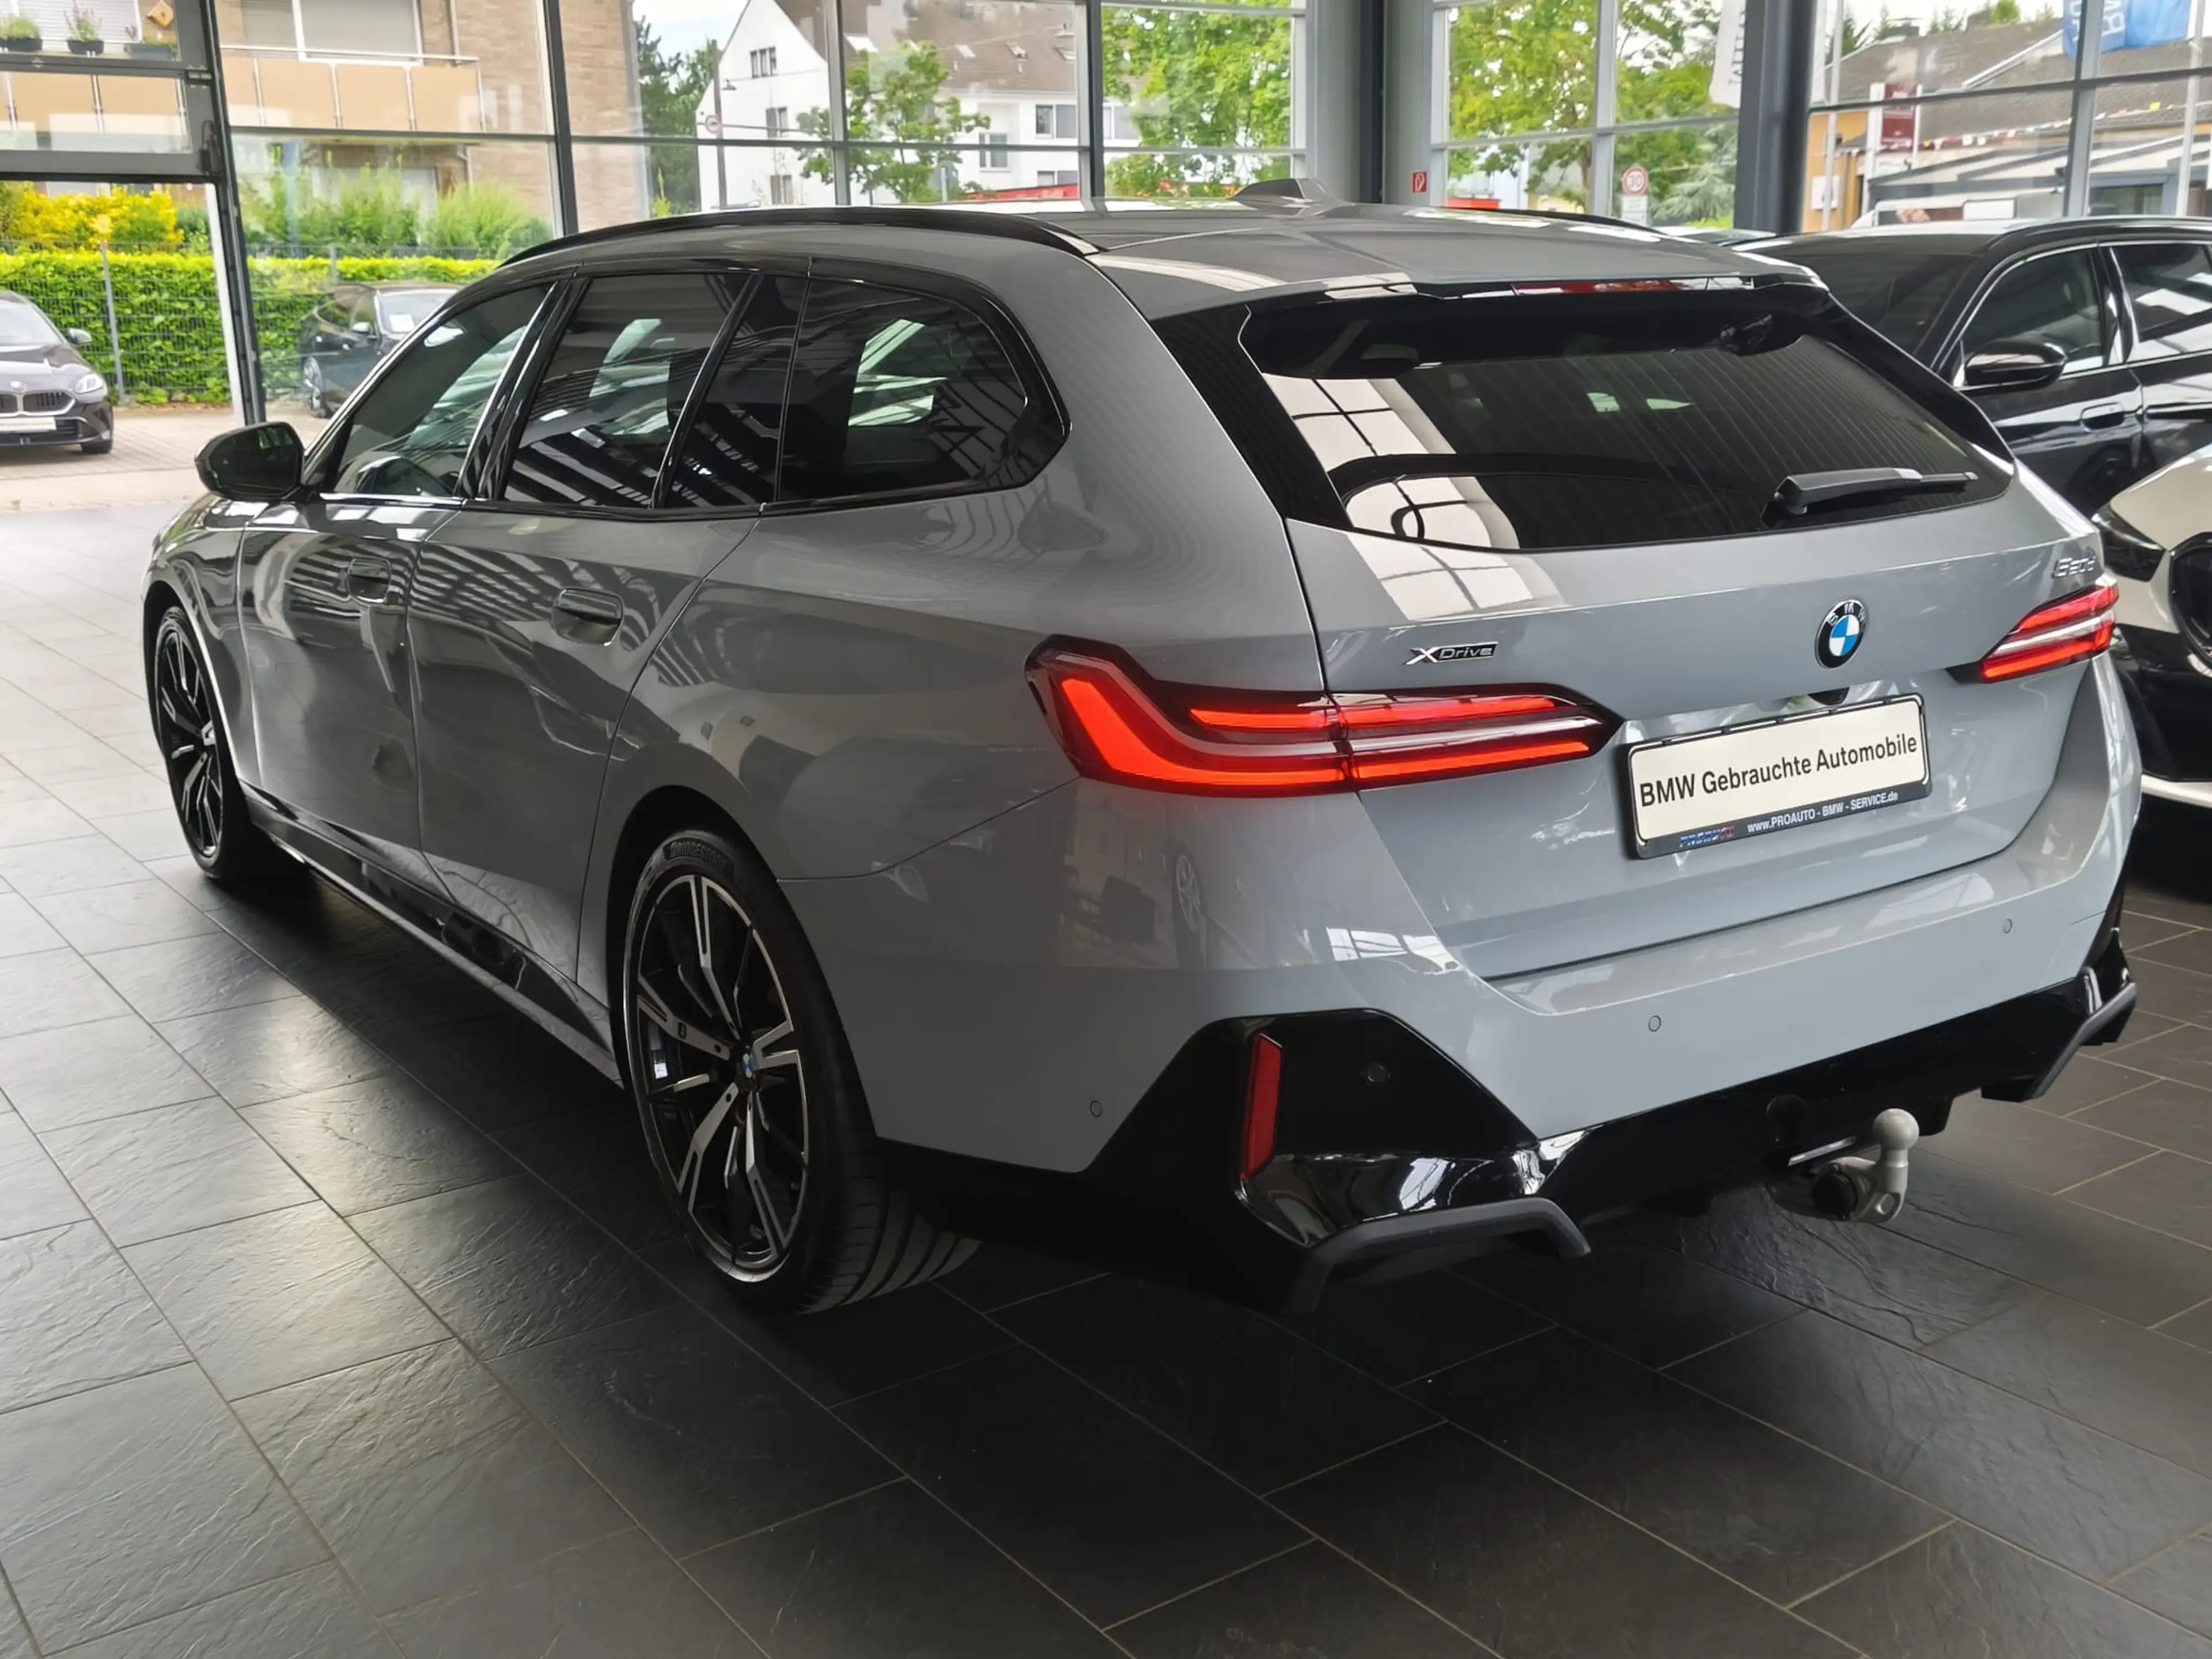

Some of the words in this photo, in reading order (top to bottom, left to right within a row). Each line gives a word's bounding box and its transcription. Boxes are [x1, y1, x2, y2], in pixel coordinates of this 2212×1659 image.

[1639, 773, 1695, 806] BMW
[1702, 757, 1812, 794] Gebrauchte
[1816, 734, 1917, 771] Automobile
[1822, 802, 1844, 817] BMW
[1850, 791, 1898, 810] SERVICE.de
